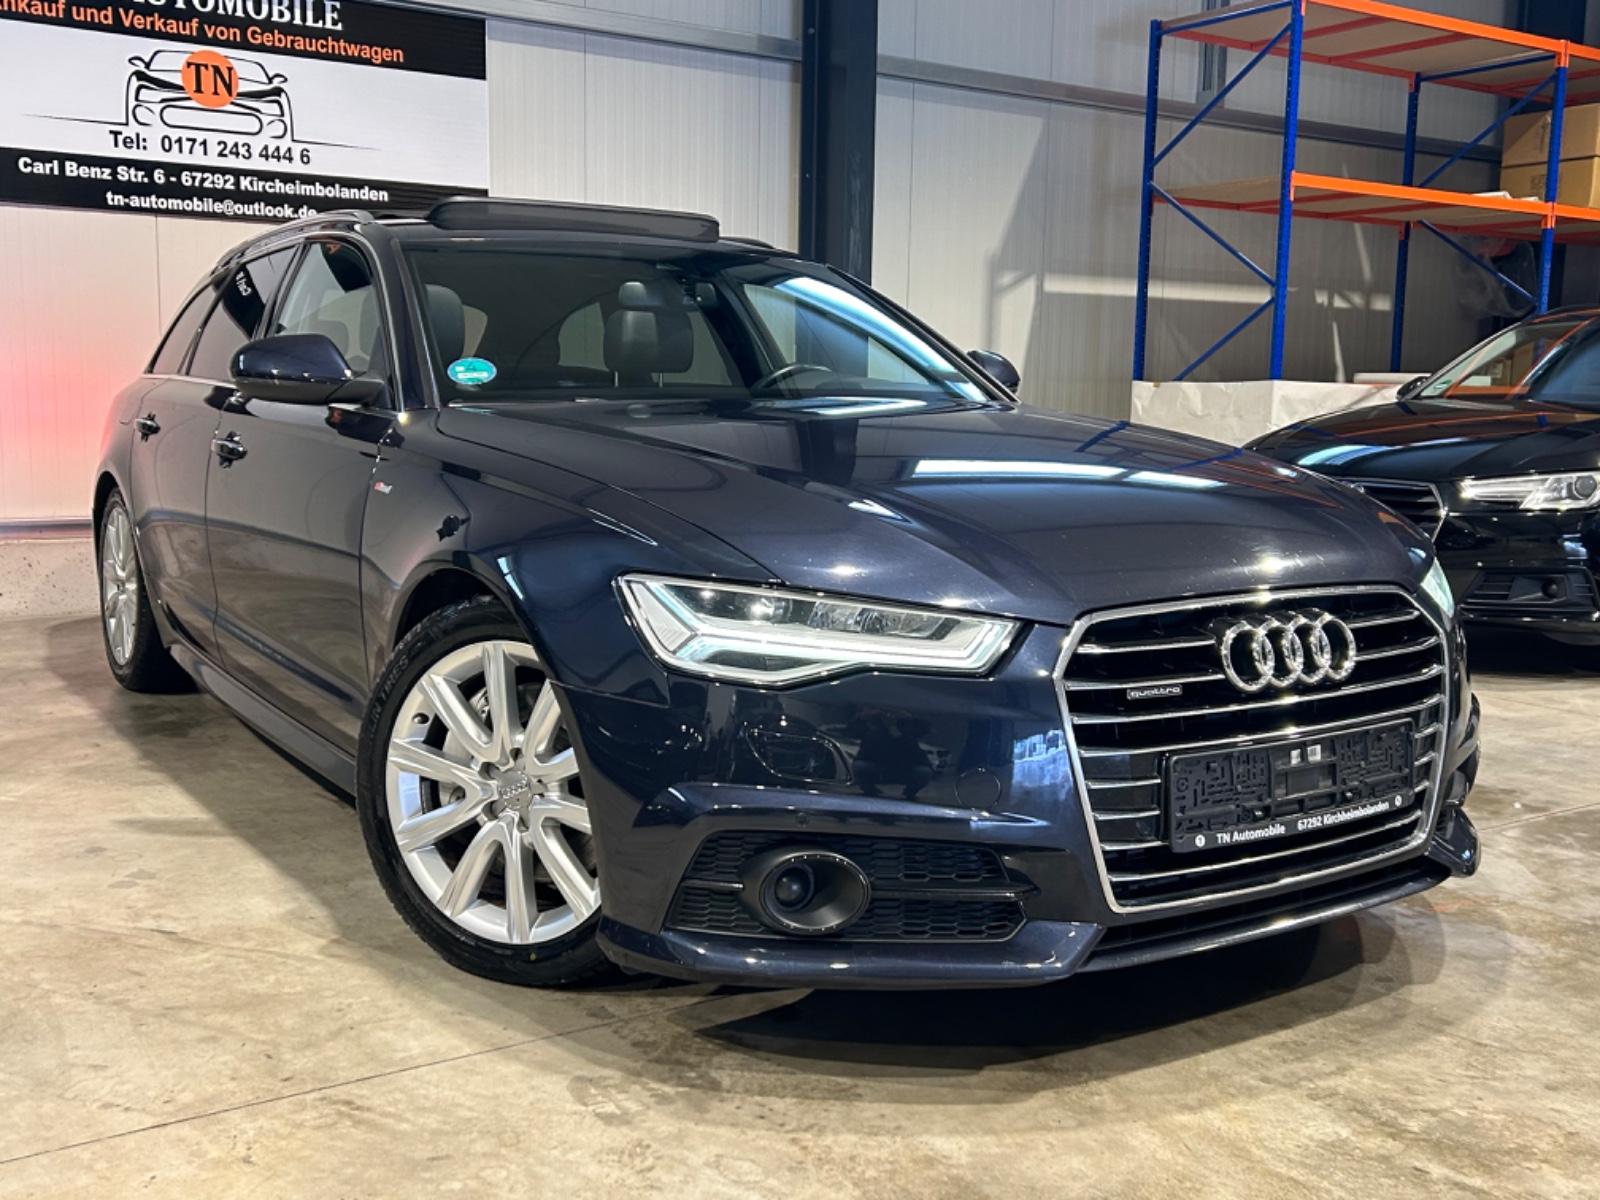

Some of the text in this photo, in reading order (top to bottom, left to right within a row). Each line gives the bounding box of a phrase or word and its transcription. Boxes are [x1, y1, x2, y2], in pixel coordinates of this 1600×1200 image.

[134, 0, 343, 30] MOBILE
[0, 0, 405, 64] nkauf und Verkauf von Gebrauchtwagen
[186, 61, 233, 97] TN
[109, 130, 311, 165] Tel: 0171 243 444 6
[18, 157, 59, 175] Carl
[65, 161, 112, 180] Benz
[116, 166, 149, 183] Str.
[153, 168, 166, 184] 6
[181, 171, 235, 190] 67292
[106, 191, 318, 218] tn-automobile@outlook.de
[1216, 833, 1231, 844] TN
[1232, 823, 1286, 842] Automobile
[1297, 815, 1322, 831] 67292
